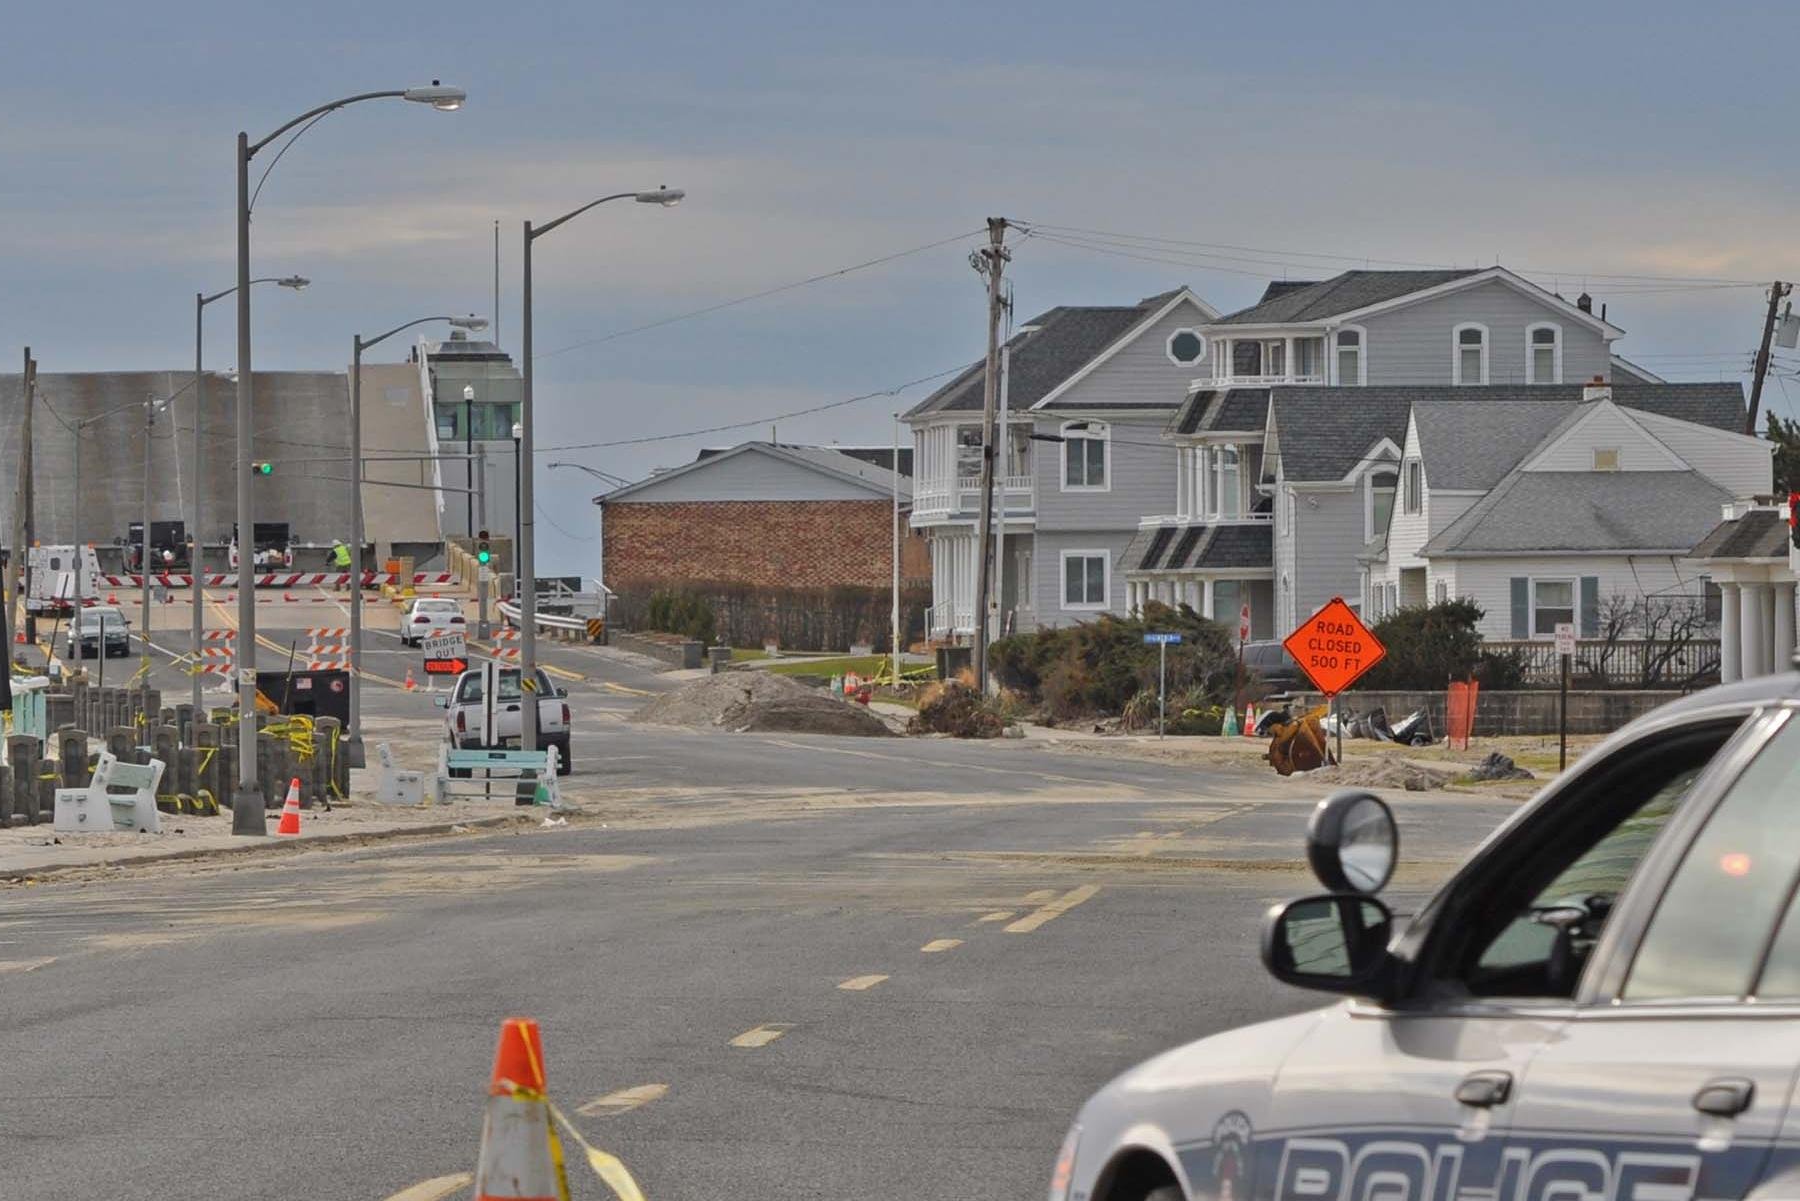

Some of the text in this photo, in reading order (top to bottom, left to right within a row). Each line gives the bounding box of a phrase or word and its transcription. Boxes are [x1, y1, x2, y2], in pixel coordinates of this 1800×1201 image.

[1317, 621, 1354, 636] ROAD
[425, 636, 463, 650] BRIDGE
[1308, 638, 1362, 654] CLOSED
[436, 647, 456, 659] OUT
[1311, 655, 1361, 671] 500 FT
[1275, 1137, 1701, 1201] POLICE
